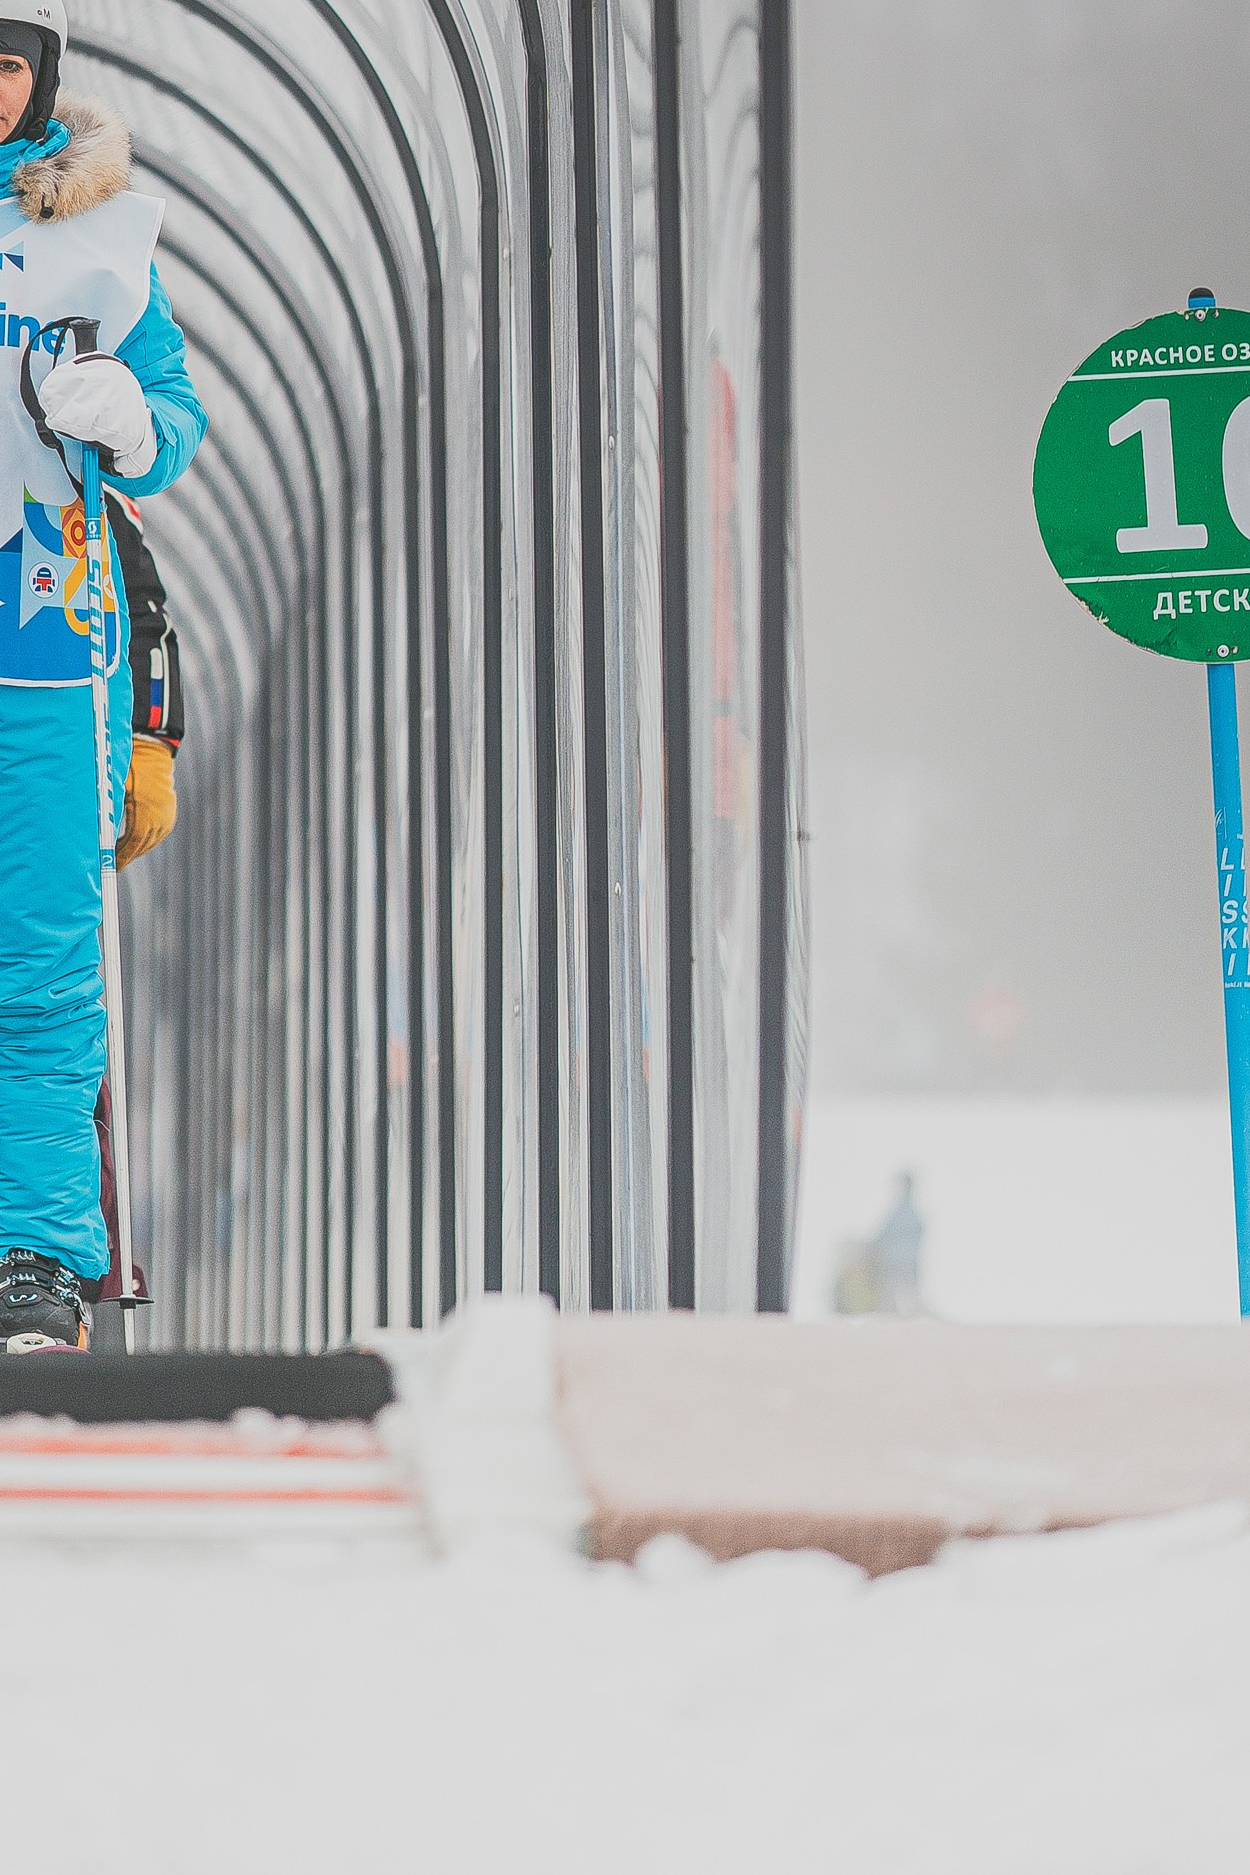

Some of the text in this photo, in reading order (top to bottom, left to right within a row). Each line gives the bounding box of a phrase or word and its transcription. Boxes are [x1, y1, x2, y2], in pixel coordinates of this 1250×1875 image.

[1111, 342, 1250, 367] КРАСНОЕ ОЗ
[1153, 588, 1250, 621] ДЕТСК
